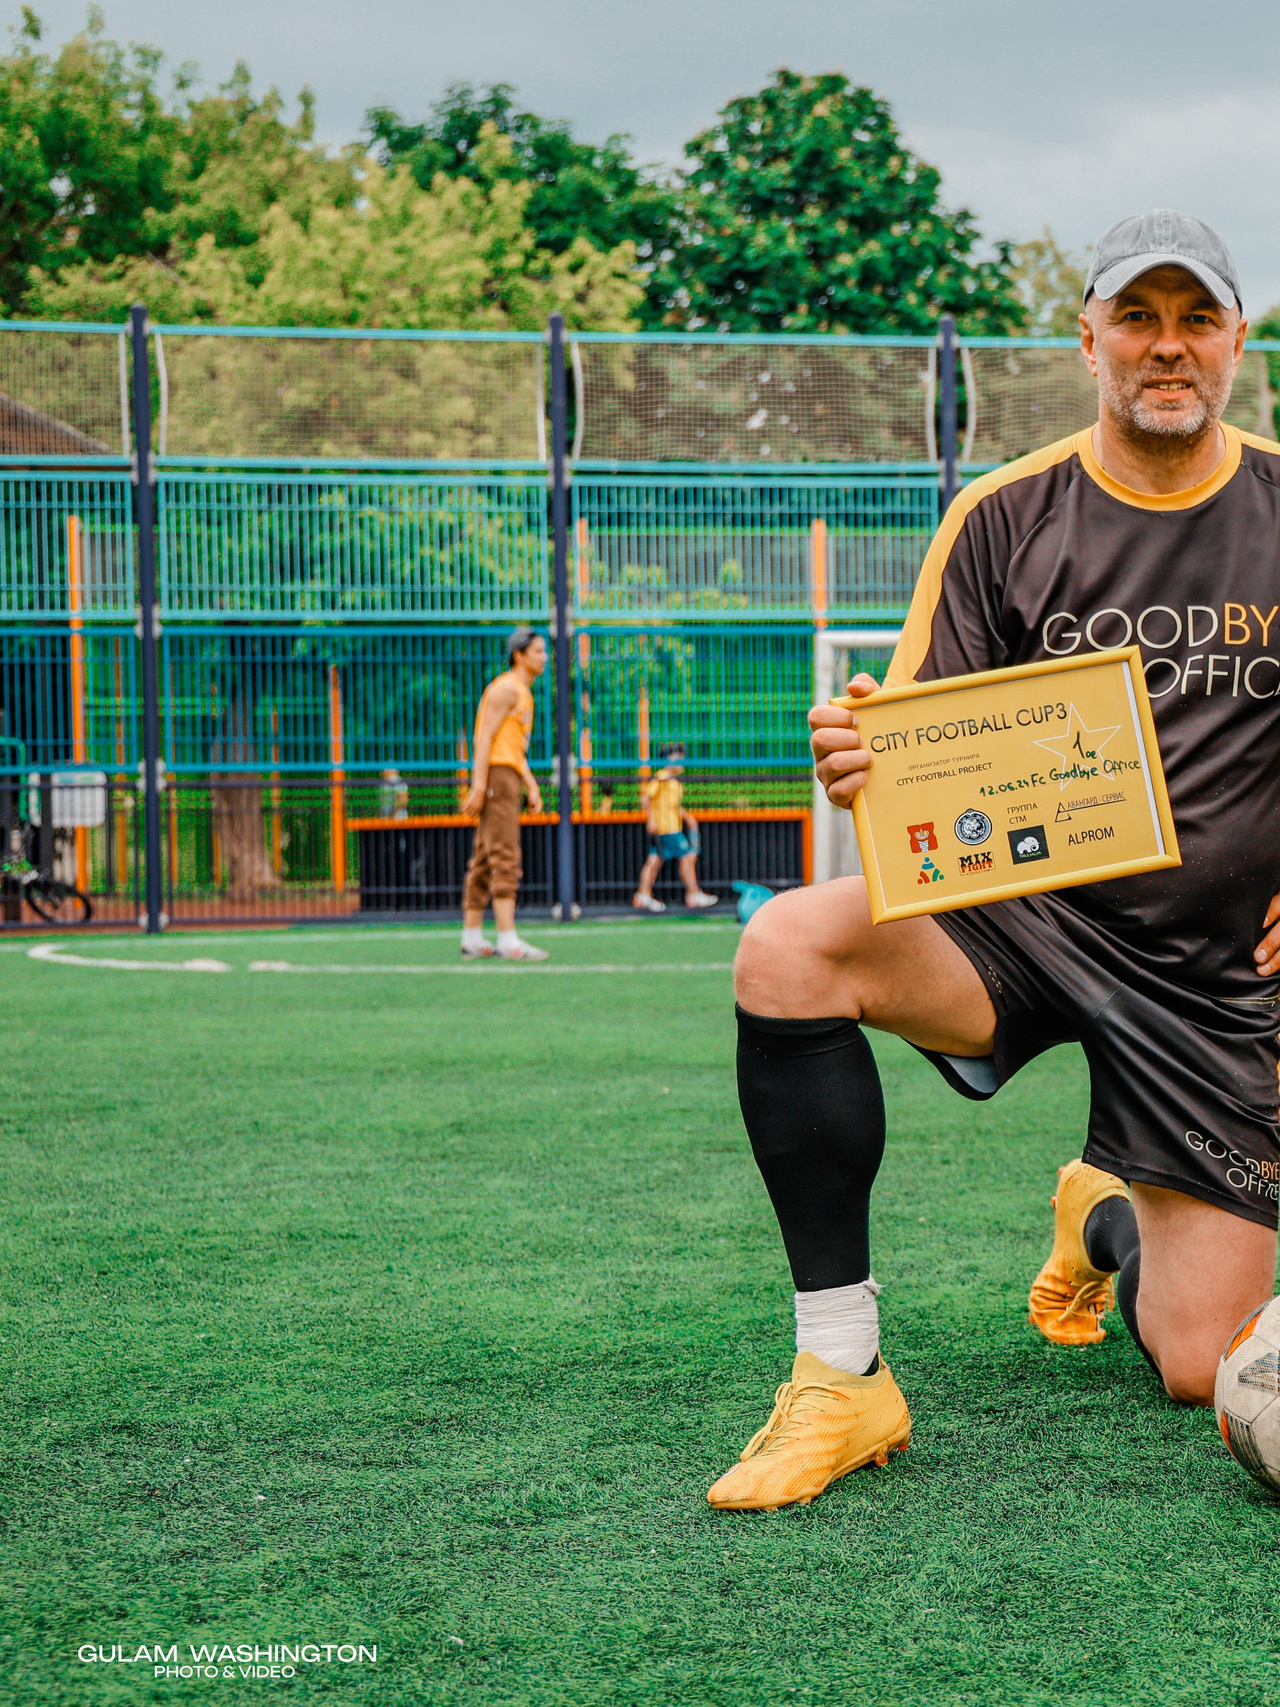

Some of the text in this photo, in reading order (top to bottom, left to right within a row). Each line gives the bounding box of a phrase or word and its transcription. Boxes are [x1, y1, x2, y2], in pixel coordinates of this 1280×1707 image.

[870, 730, 909, 753] CITY
[915, 713, 1012, 746] FOOTBALL
[908, 753, 980, 771] ОРГАНИЗАТОР ТУРНИРА
[896, 762, 993, 787] CITY FOOTBALL PROJECT
[979, 779, 1030, 797] 12.06.24
[1006, 802, 1038, 815] ГРУППА
[1009, 815, 1027, 825] СТМ
[1068, 826, 1115, 846] ALPROM
[959, 851, 993, 867] MIX
[960, 861, 994, 873] FIGHT
